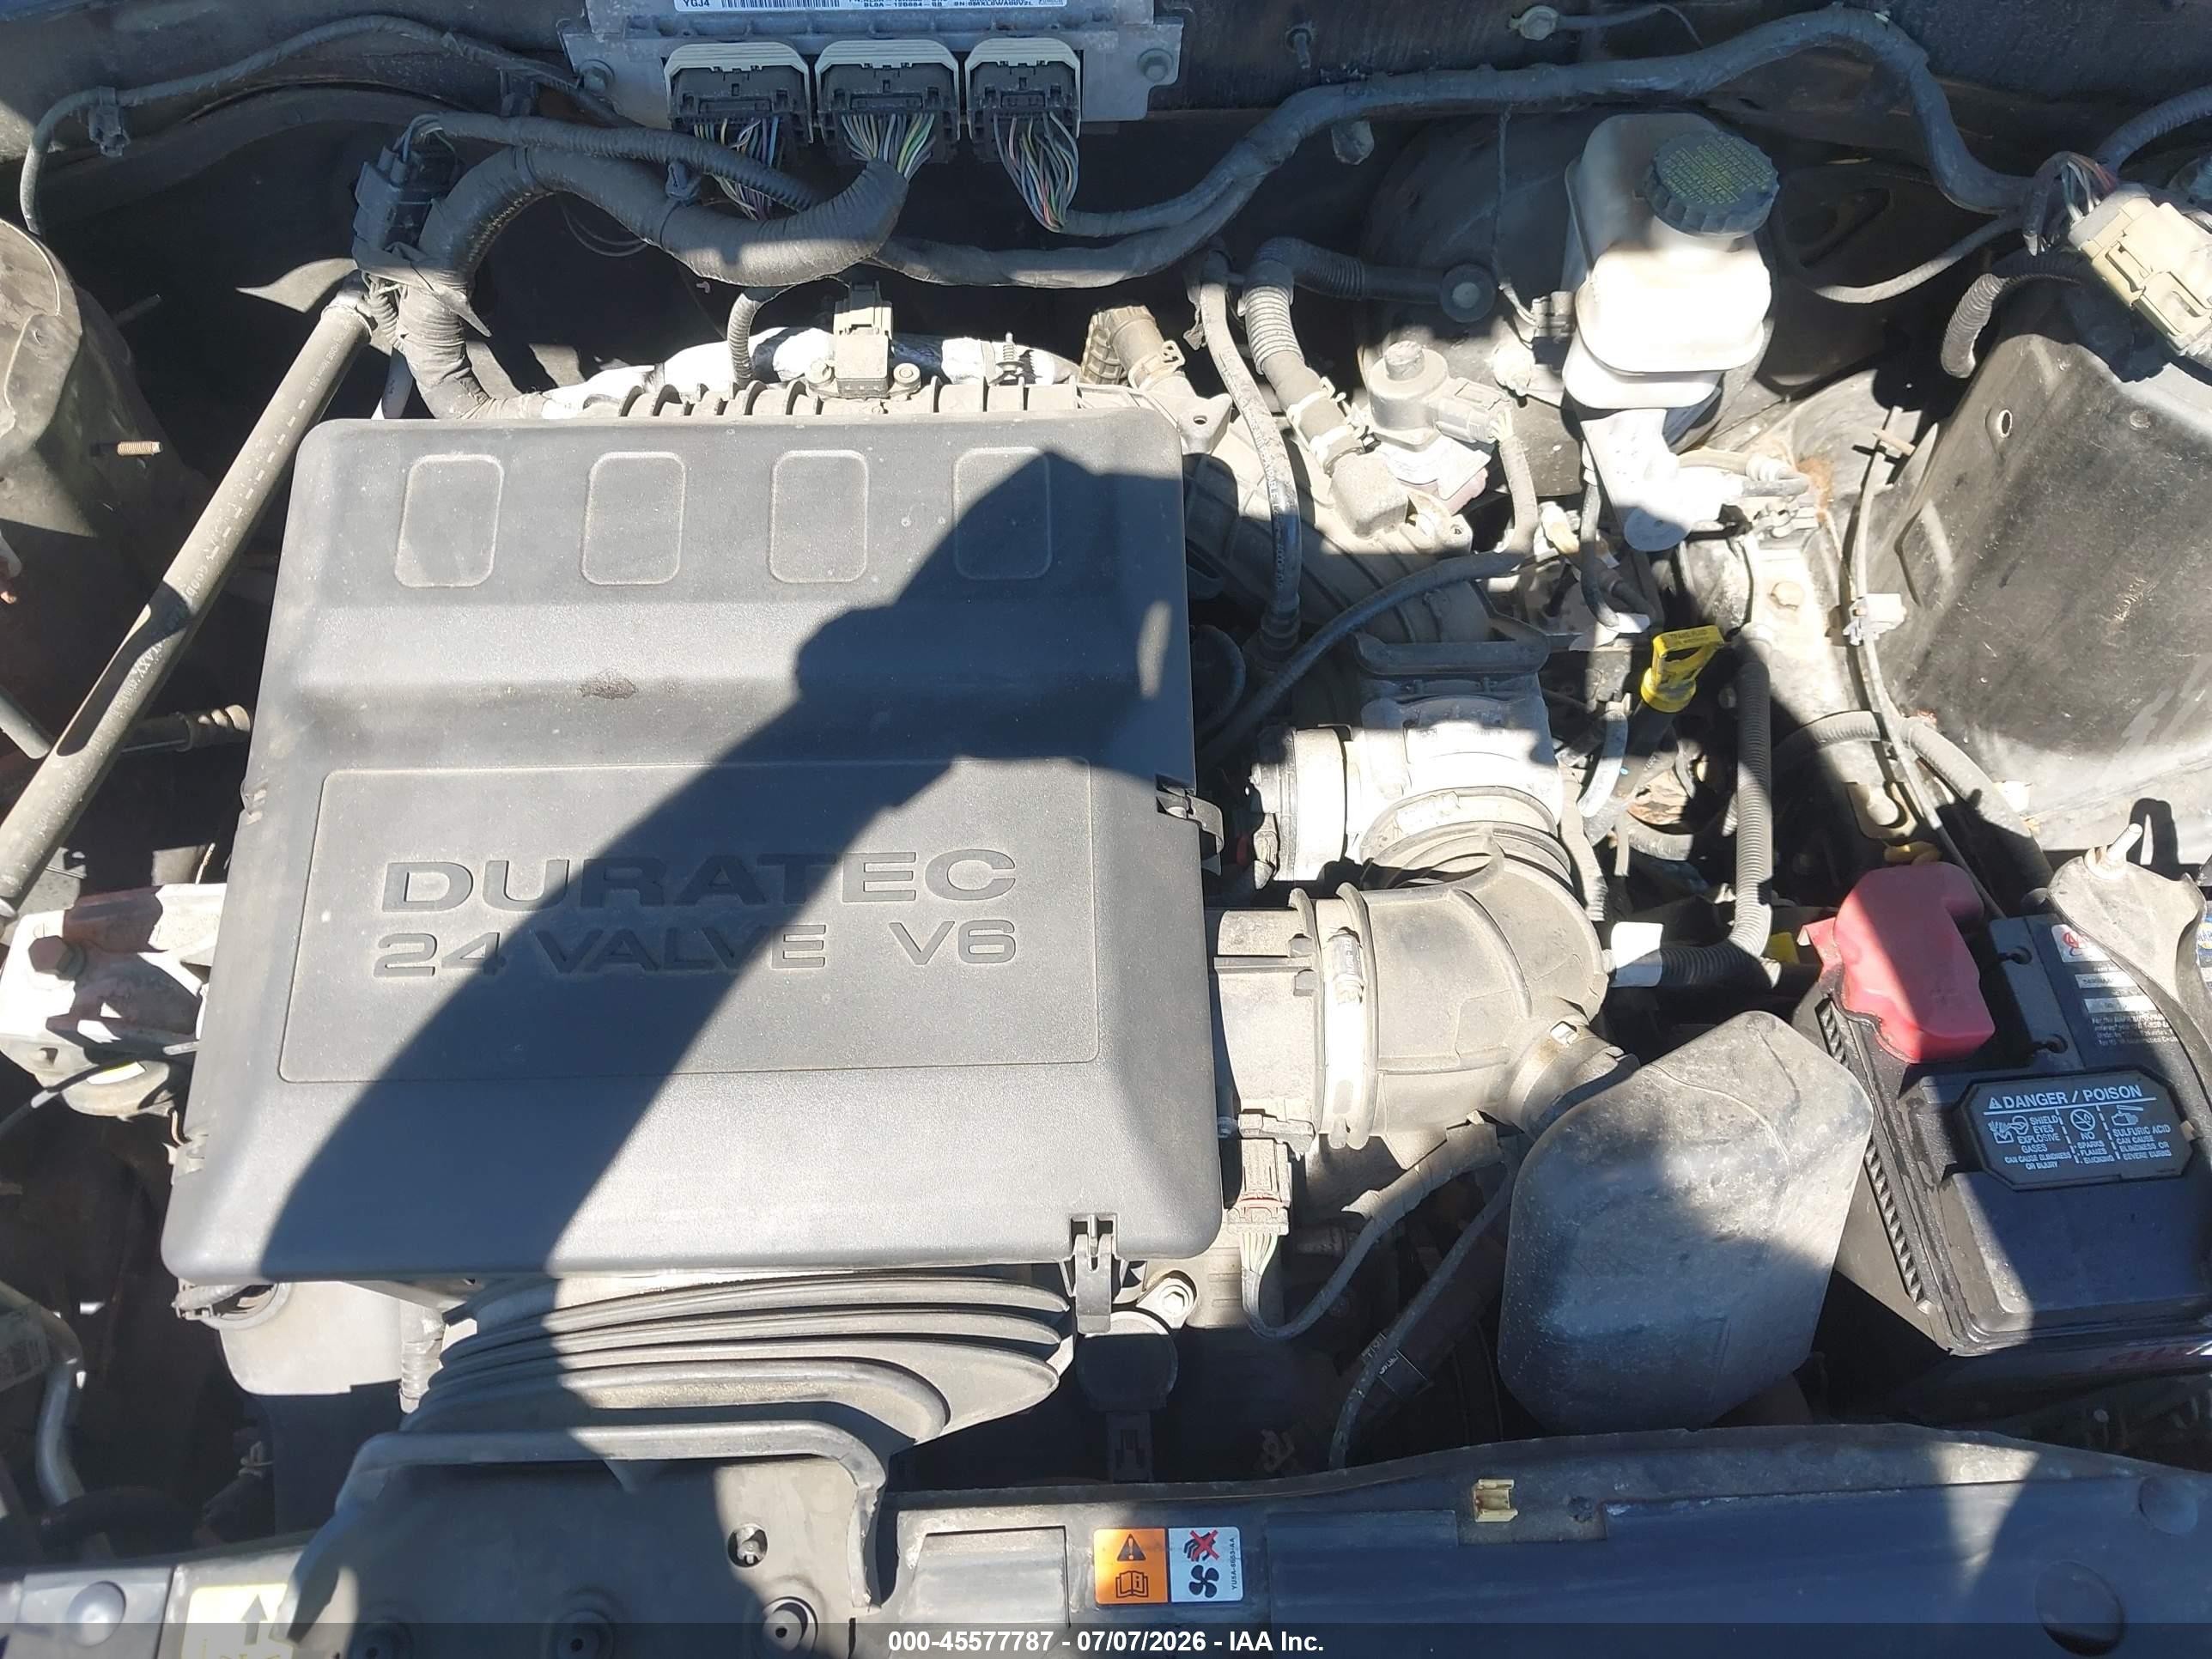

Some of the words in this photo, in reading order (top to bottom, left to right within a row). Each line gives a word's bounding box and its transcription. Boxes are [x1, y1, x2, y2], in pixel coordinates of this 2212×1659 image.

[381, 848, 1017, 914] DURATEC
[373, 931, 508, 978] 24
[536, 922, 827, 975] VALVE
[889, 919, 1017, 966] V6
[2002, 1091, 2069, 1109] DANGER
[2071, 1090, 2079, 1103] /
[2082, 1085, 2143, 1103] POISON
[2030, 1115, 2059, 1127] SHIELD
[2033, 1125, 2055, 1134] EYES
[2081, 1131, 2096, 1140] NO
[2112, 1127, 2152, 1139] SULFURIC
[2151, 1124, 2172, 1134] ACID
[2017, 1133, 2062, 1145] EXPLOSIVE
[2116, 1136, 2131, 1145] CAN
[2157, 1140, 2171, 1150] OR
[2021, 1144, 2048, 1153] GASES
